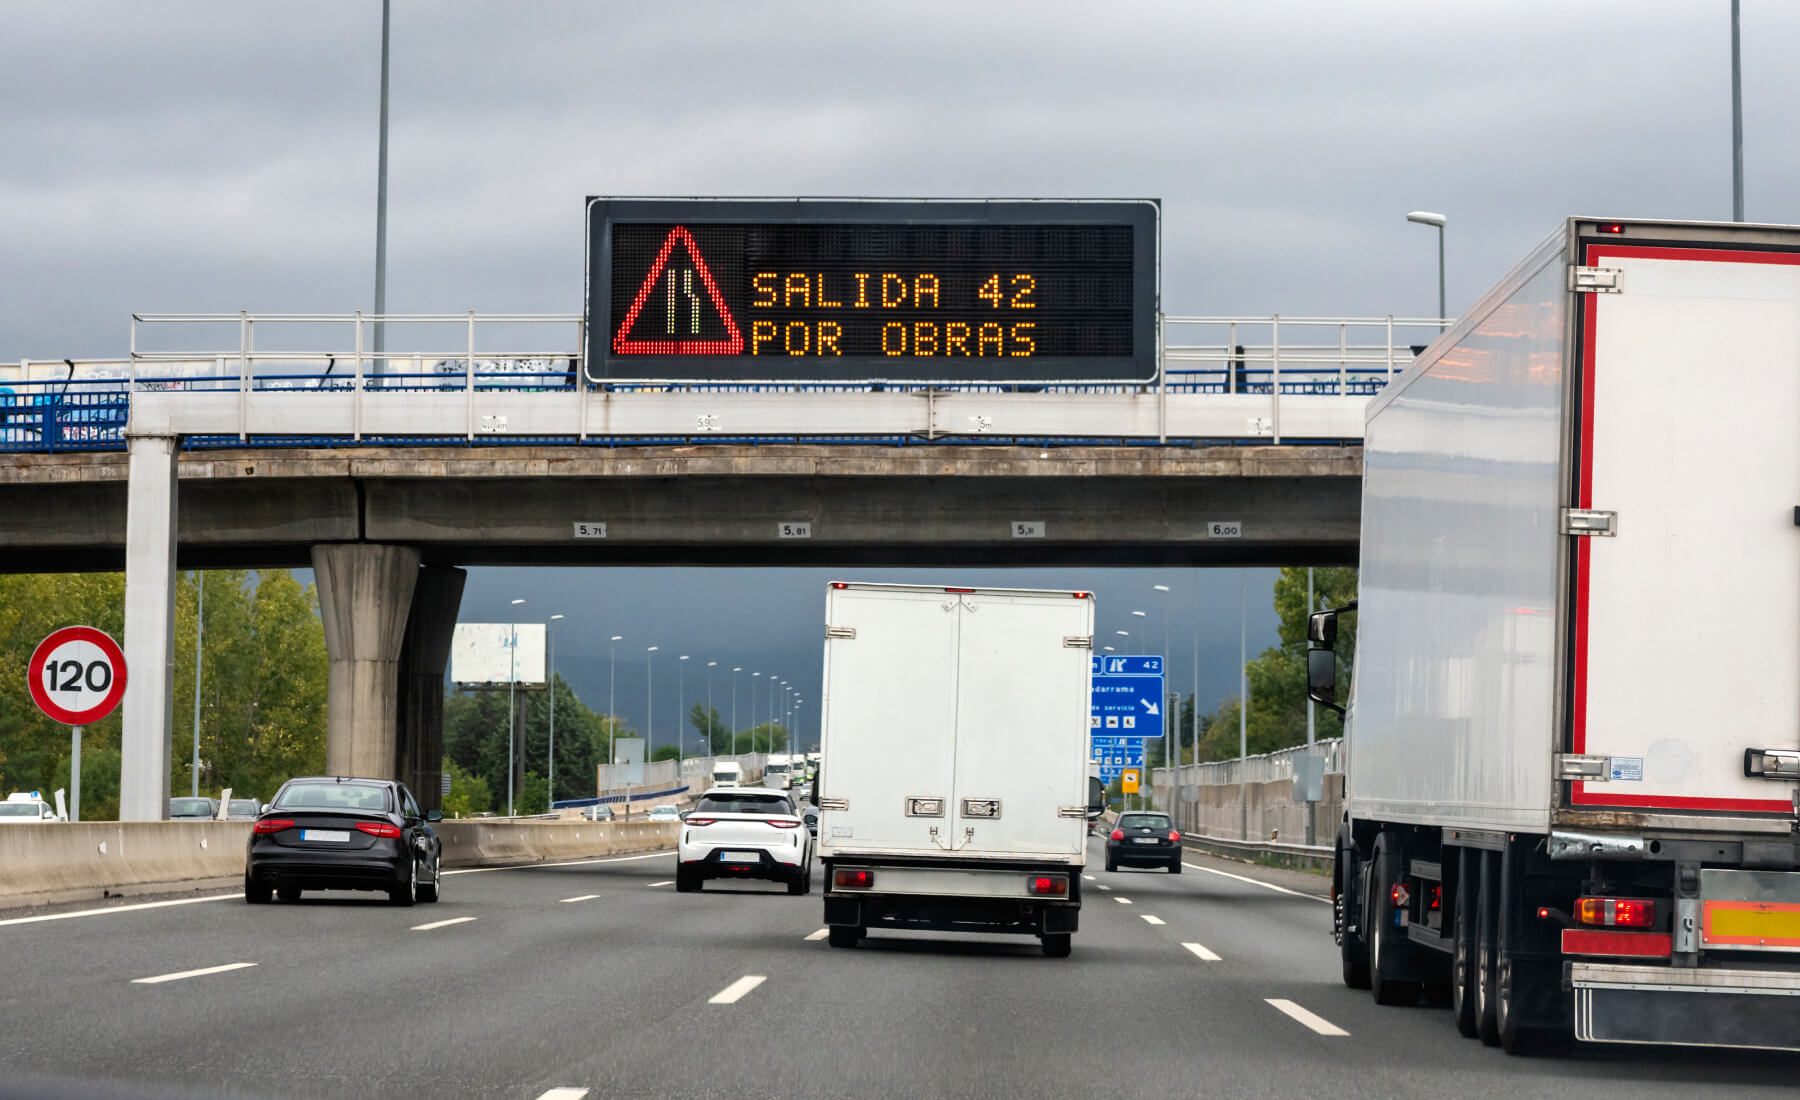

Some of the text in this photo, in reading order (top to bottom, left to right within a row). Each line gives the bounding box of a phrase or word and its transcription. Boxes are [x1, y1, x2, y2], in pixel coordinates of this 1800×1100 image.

[752, 272, 1037, 310] SALIDA 42
[751, 320, 1037, 358] POR OBRAS
[45, 659, 112, 693] 120
[1143, 660, 1159, 669] 42
